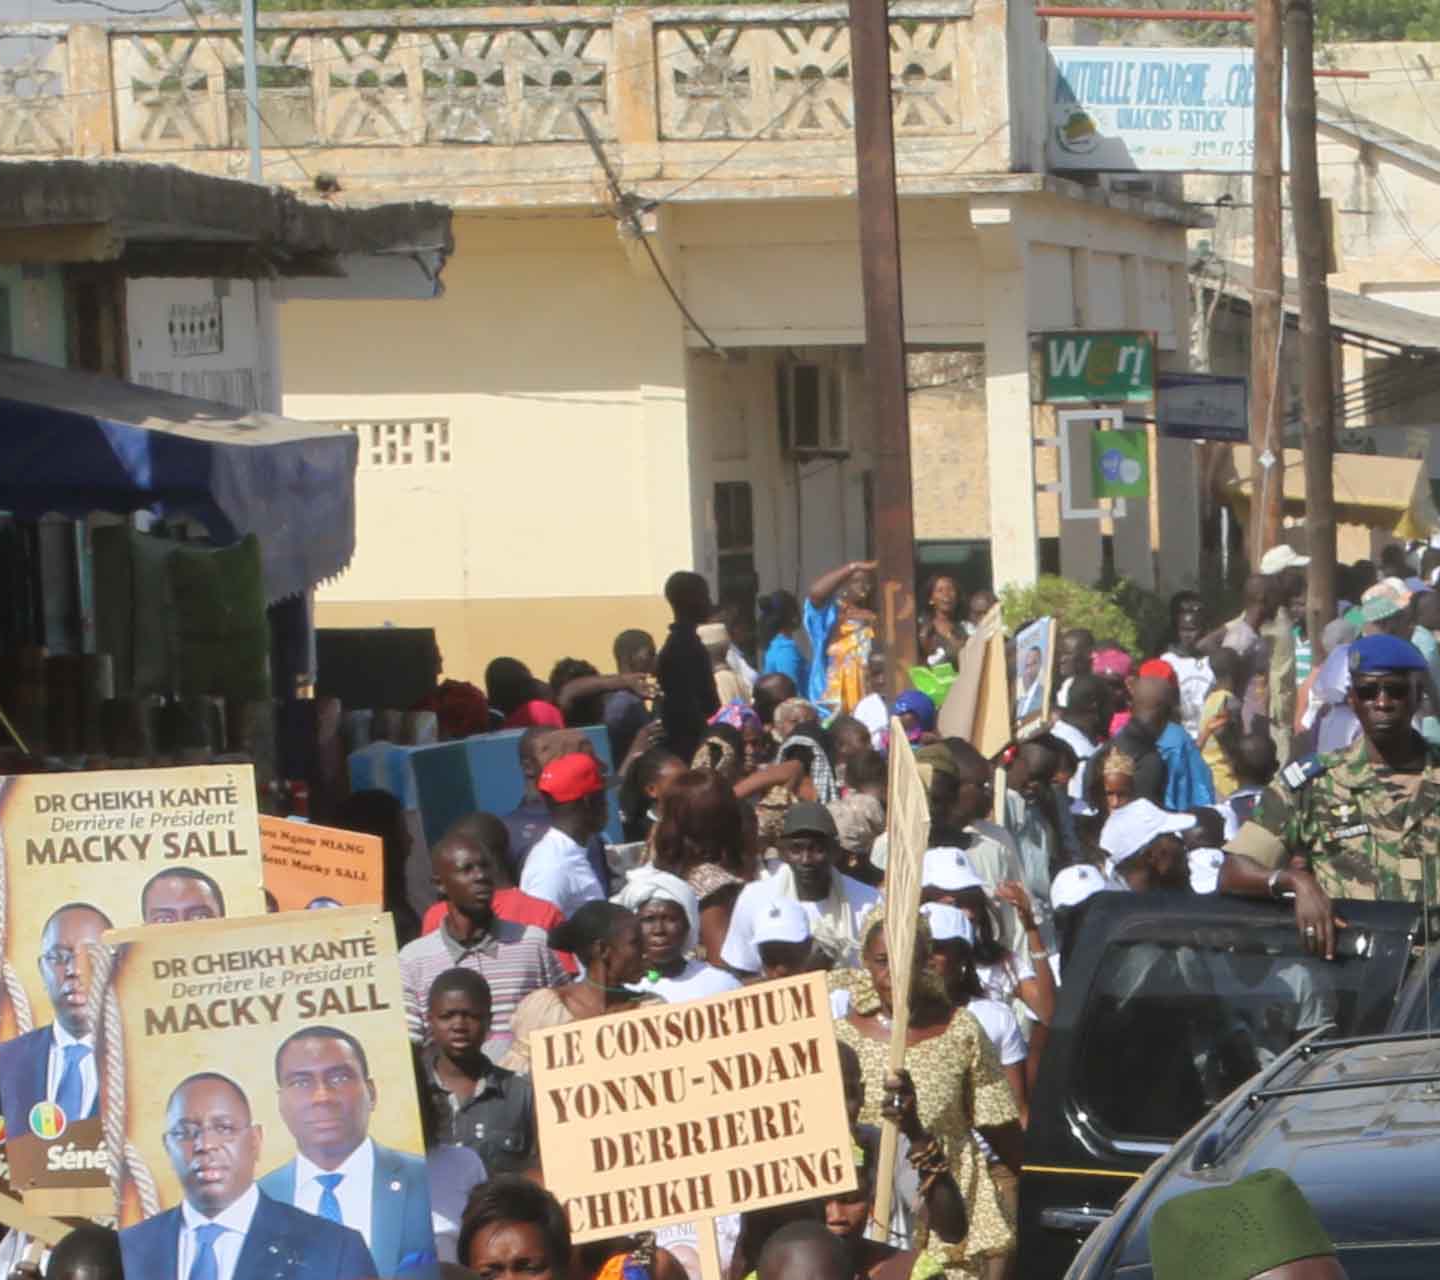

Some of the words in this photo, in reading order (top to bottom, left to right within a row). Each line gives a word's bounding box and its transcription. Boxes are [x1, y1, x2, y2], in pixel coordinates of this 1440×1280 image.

[34, 791, 66, 814] DR
[70, 787, 157, 813] CHEIKH
[49, 809, 126, 832] Derrière
[128, 809, 147, 829] le
[150, 807, 236, 831] Président
[24, 831, 156, 867] MACKY
[162, 829, 248, 859] SALL
[151, 957, 189, 981] DR
[192, 947, 287, 979] CHEIKH
[291, 930, 378, 964] KANTÉ
[170, 974, 255, 1001] Derrière
[257, 970, 278, 991] le
[280, 959, 376, 989] Président
[143, 991, 285, 1039] MACKY
[295, 981, 391, 1020] SALL
[544, 1029, 586, 1071] LE
[595, 982, 818, 1062] CONSORTIUM
[547, 1036, 824, 1126] YONNU-NDAM
[590, 1098, 806, 1175] DERRIERE
[727, 1146, 845, 1206] DIENG
